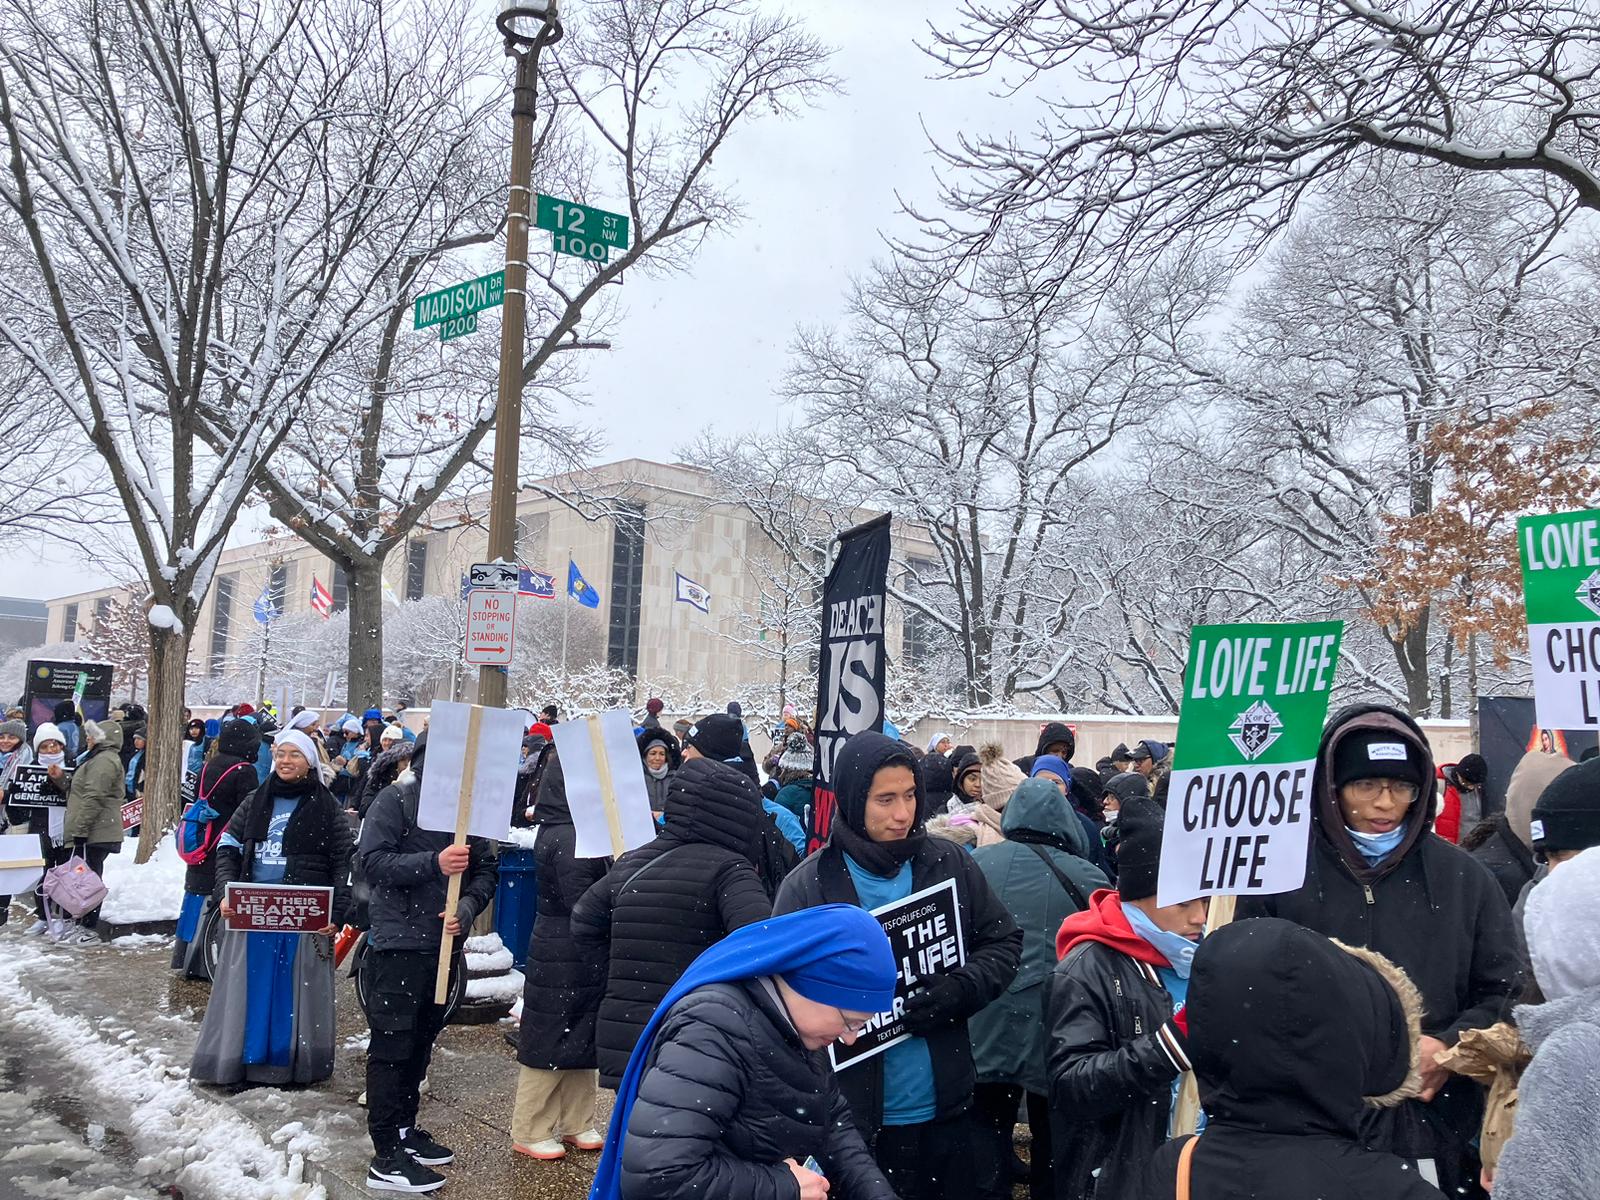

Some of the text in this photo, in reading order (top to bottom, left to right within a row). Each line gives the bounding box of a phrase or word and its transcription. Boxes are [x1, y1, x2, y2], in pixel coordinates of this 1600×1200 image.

[552, 204, 619, 235] 12 ST
[602, 229, 618, 242] NW
[555, 234, 607, 260] 100
[419, 276, 502, 324] MADISON DR
[489, 289, 502, 303] NW
[441, 315, 476, 338] 1200
[1525, 519, 1600, 570] LOVE
[485, 599, 499, 610] NO
[472, 612, 510, 622] STOPPING
[829, 595, 882, 638] DEATH
[486, 623, 495, 631] OR
[471, 632, 509, 642] STANDING
[1191, 634, 1335, 700] LOVE LIFE
[821, 640, 880, 736] IS
[1244, 714, 1252, 723] K
[1264, 714, 1272, 723] C
[20, 773, 48, 782] I AM
[1183, 768, 1308, 832] CHOOSE
[1200, 834, 1270, 891] LIFE
[241, 896, 318, 905] LET THEIR
[236, 904, 321, 916] HEARTS
[251, 915, 306, 927] BEAT
[902, 913, 948, 949] THE
[877, 1029, 892, 1042] TEXT
